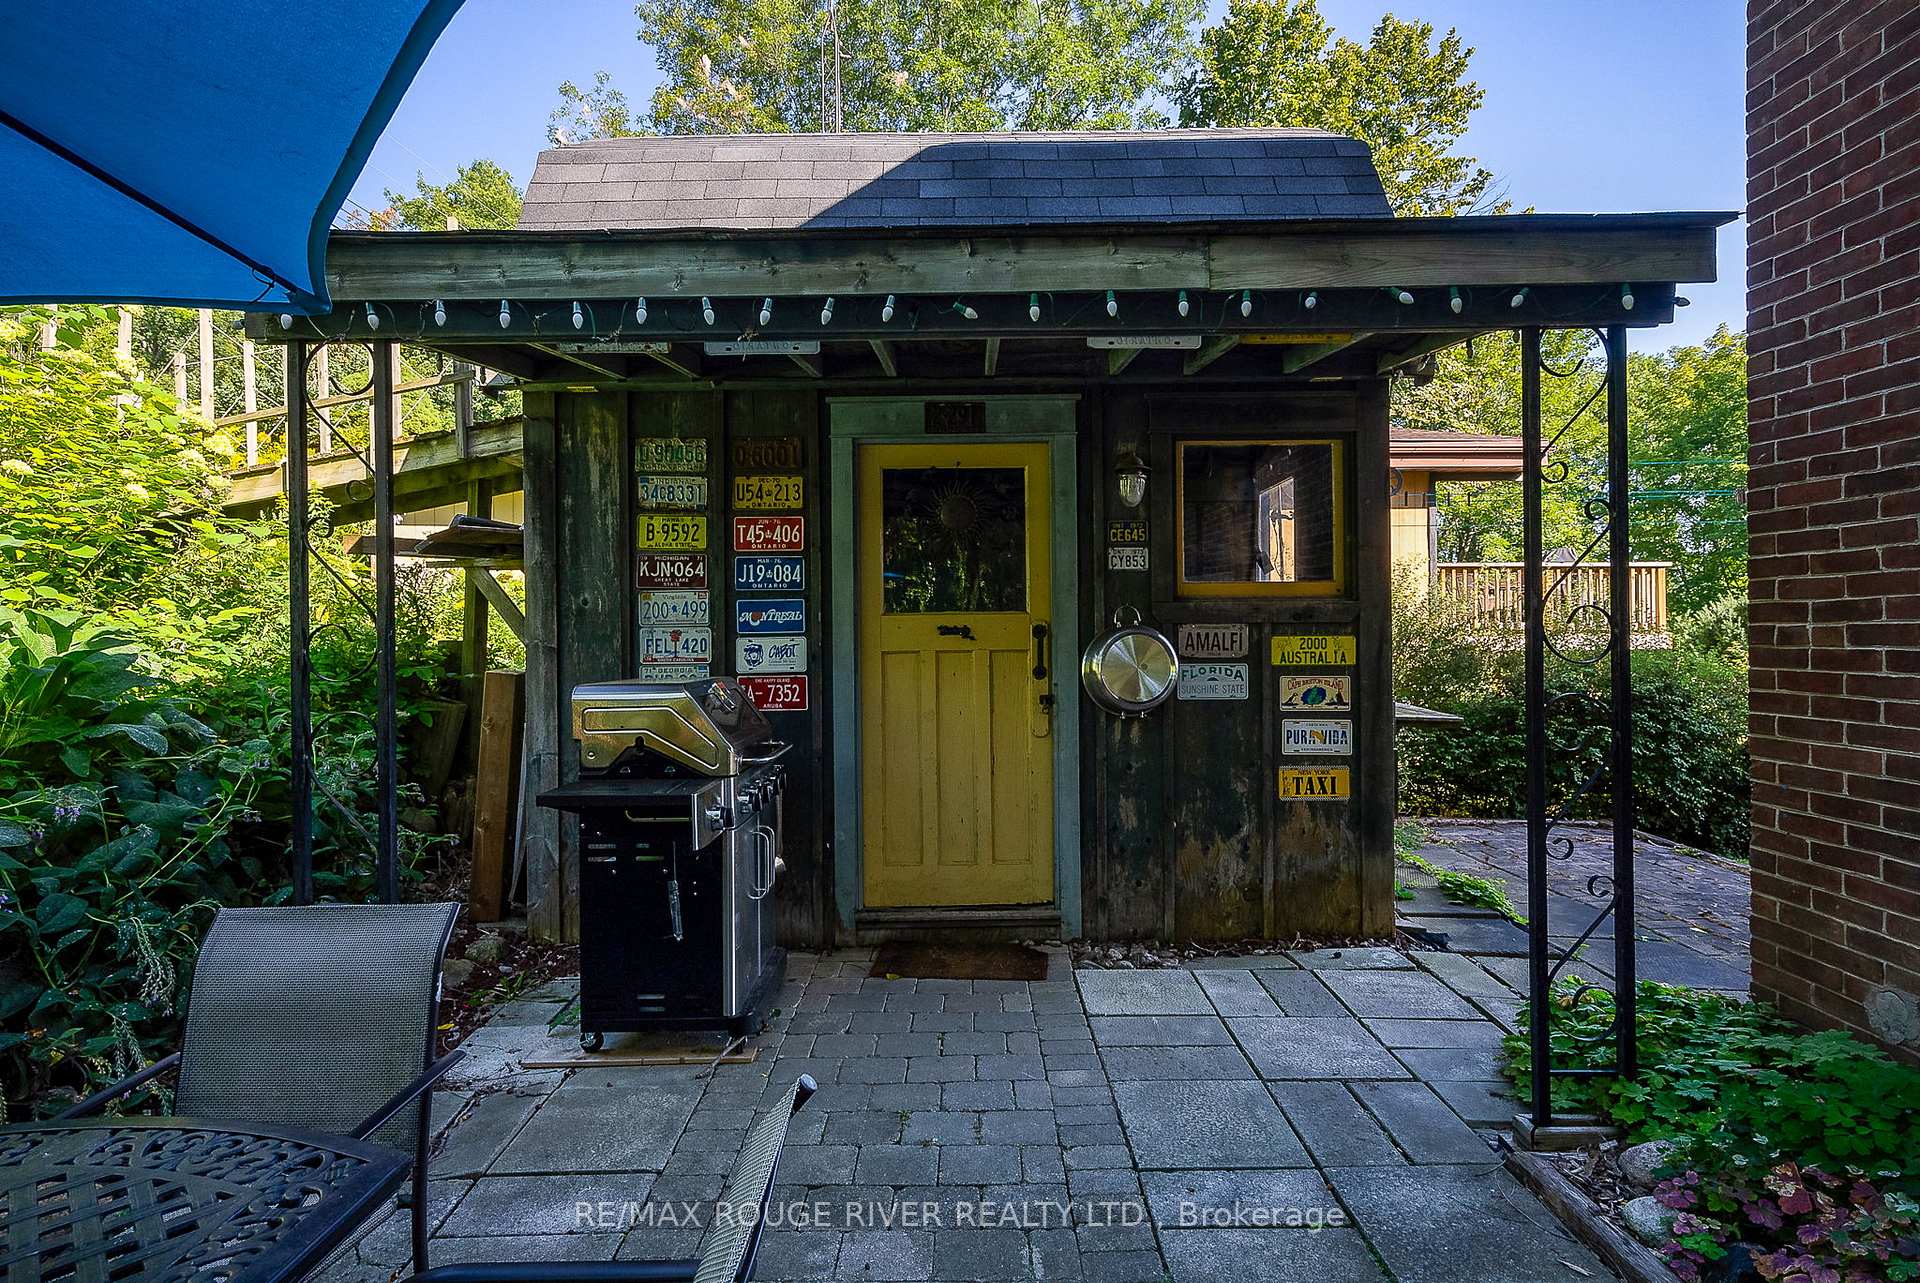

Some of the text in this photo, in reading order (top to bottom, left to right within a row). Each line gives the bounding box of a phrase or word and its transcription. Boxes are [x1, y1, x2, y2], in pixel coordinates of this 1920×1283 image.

[640, 484, 702, 502] 34C8331
[736, 483, 801, 502] U54 213
[646, 523, 700, 542] B-9592
[737, 524, 801, 544] T45 406
[1110, 528, 1146, 543] CE645
[1110, 554, 1146, 569] CY853
[738, 563, 802, 583] J19 084
[643, 600, 708, 620] 200 499
[739, 608, 803, 627] MONTREAL
[681, 637, 708, 653] 420
[1184, 631, 1243, 652] AMALFI
[1299, 637, 1328, 651] 2000
[1279, 650, 1347, 664] AUSTRALIA
[1181, 666, 1245, 682] FLORIDA
[1181, 683, 1245, 695] SUNSHINE STATE
[1292, 776, 1337, 795] TAXI
